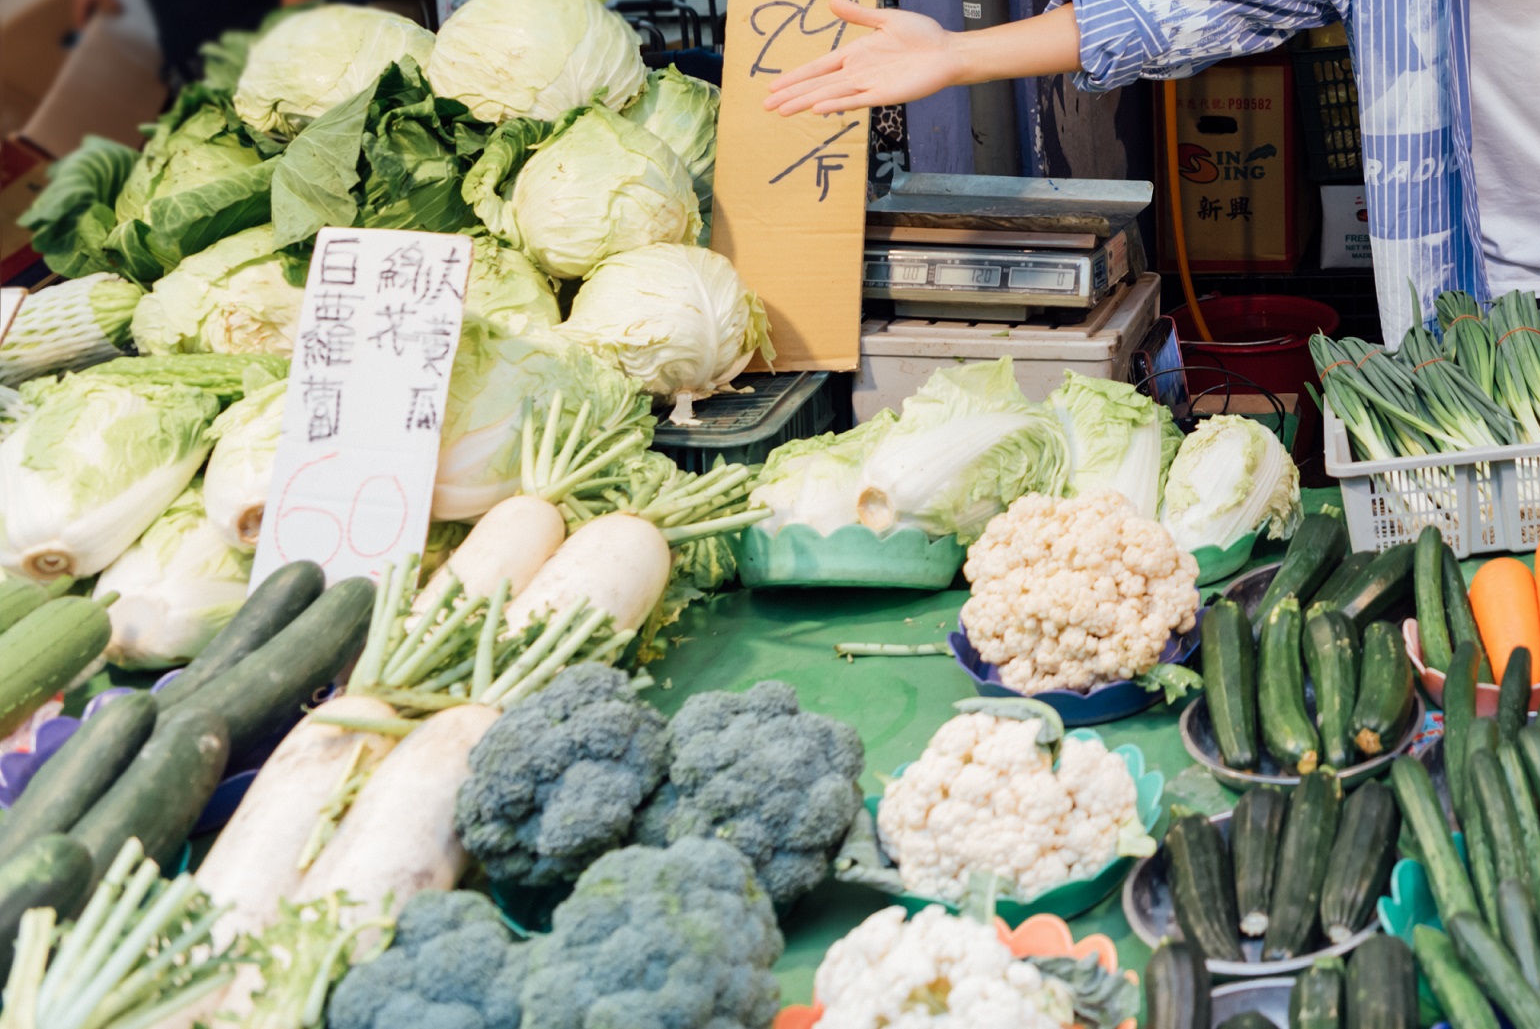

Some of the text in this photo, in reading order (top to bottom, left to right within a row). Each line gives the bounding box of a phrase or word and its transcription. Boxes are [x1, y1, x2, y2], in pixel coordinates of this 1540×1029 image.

[1228, 97, 1272, 111] P99582
[1197, 196, 1254, 222] 新興
[1345, 234, 1370, 242] FRES
[273, 451, 409, 570] 60
